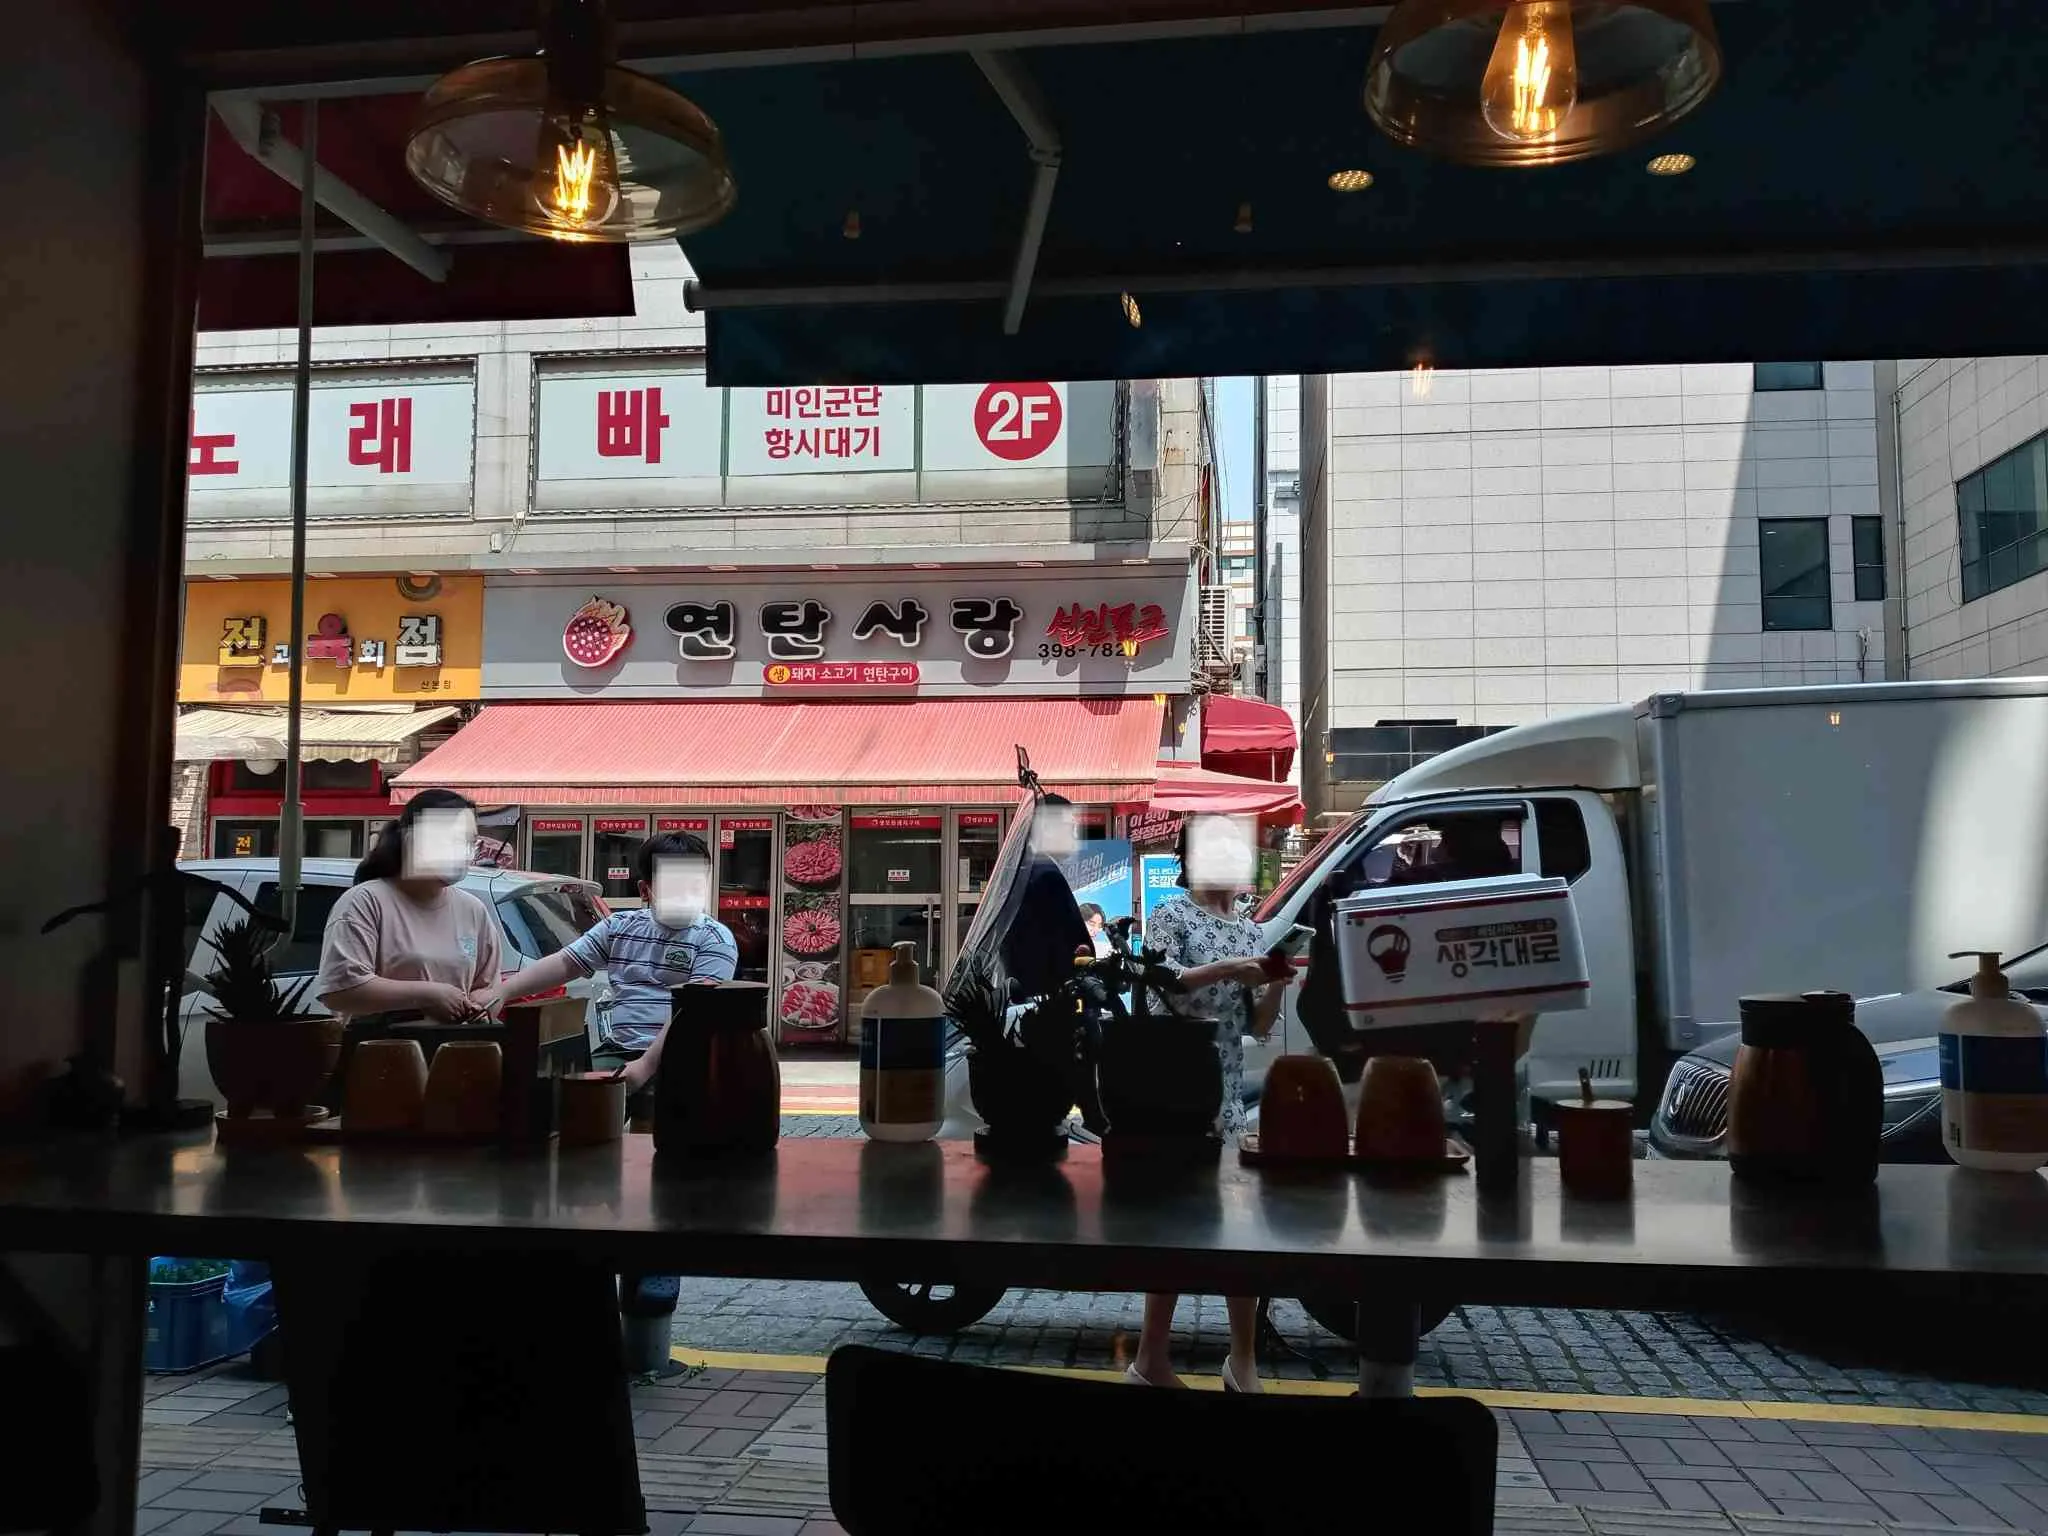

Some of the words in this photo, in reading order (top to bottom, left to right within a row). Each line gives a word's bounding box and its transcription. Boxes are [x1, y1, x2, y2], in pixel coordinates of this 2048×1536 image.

[765, 385, 882, 420] 미인군단
[986, 391, 1050, 441] 2F
[348, 397, 413, 474] 래
[597, 387, 670, 464] 빠
[764, 426, 880, 459] 항시대기
[663, 597, 1024, 661] 연탄사랑
[863, 666, 913, 683] 연탄구이
[235, 835, 252, 855] 전
[1437, 934, 1560, 978] 생각대로
